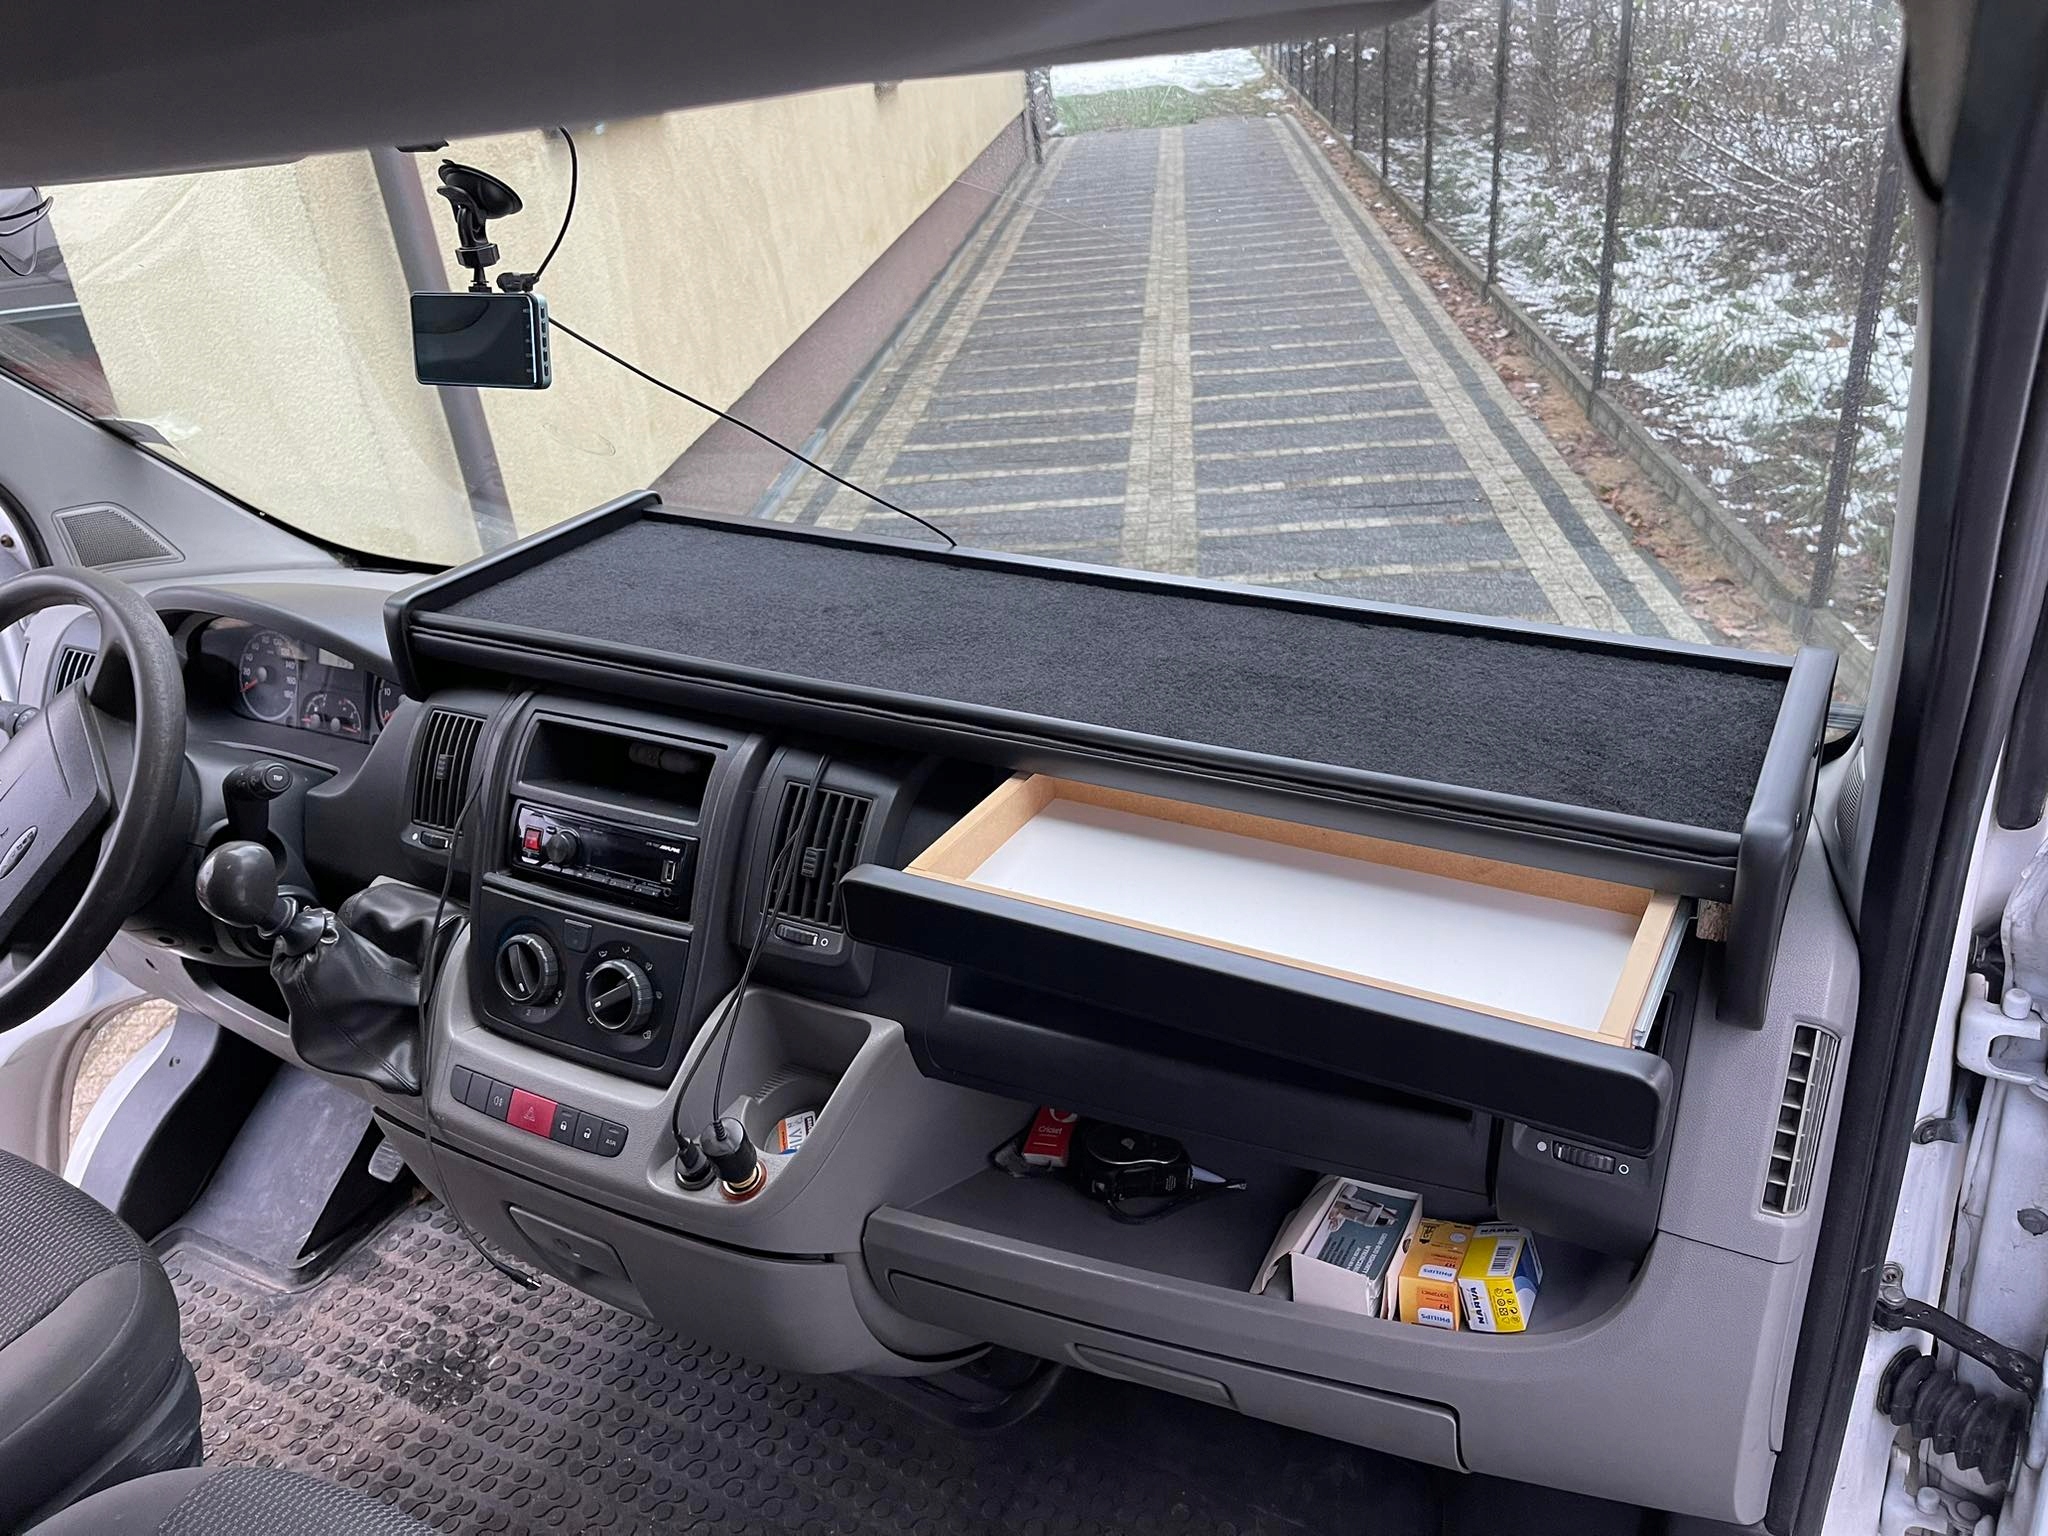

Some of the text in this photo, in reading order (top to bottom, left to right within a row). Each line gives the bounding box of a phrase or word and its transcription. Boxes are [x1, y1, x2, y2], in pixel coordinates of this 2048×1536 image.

[606, 1138, 616, 1146] ASR
[1423, 1268, 1453, 1277] PHILIPS
[1438, 1303, 1450, 1311] H7
[1470, 1286, 1485, 1325] NARVA
[1420, 1313, 1451, 1324] PHILIPS
